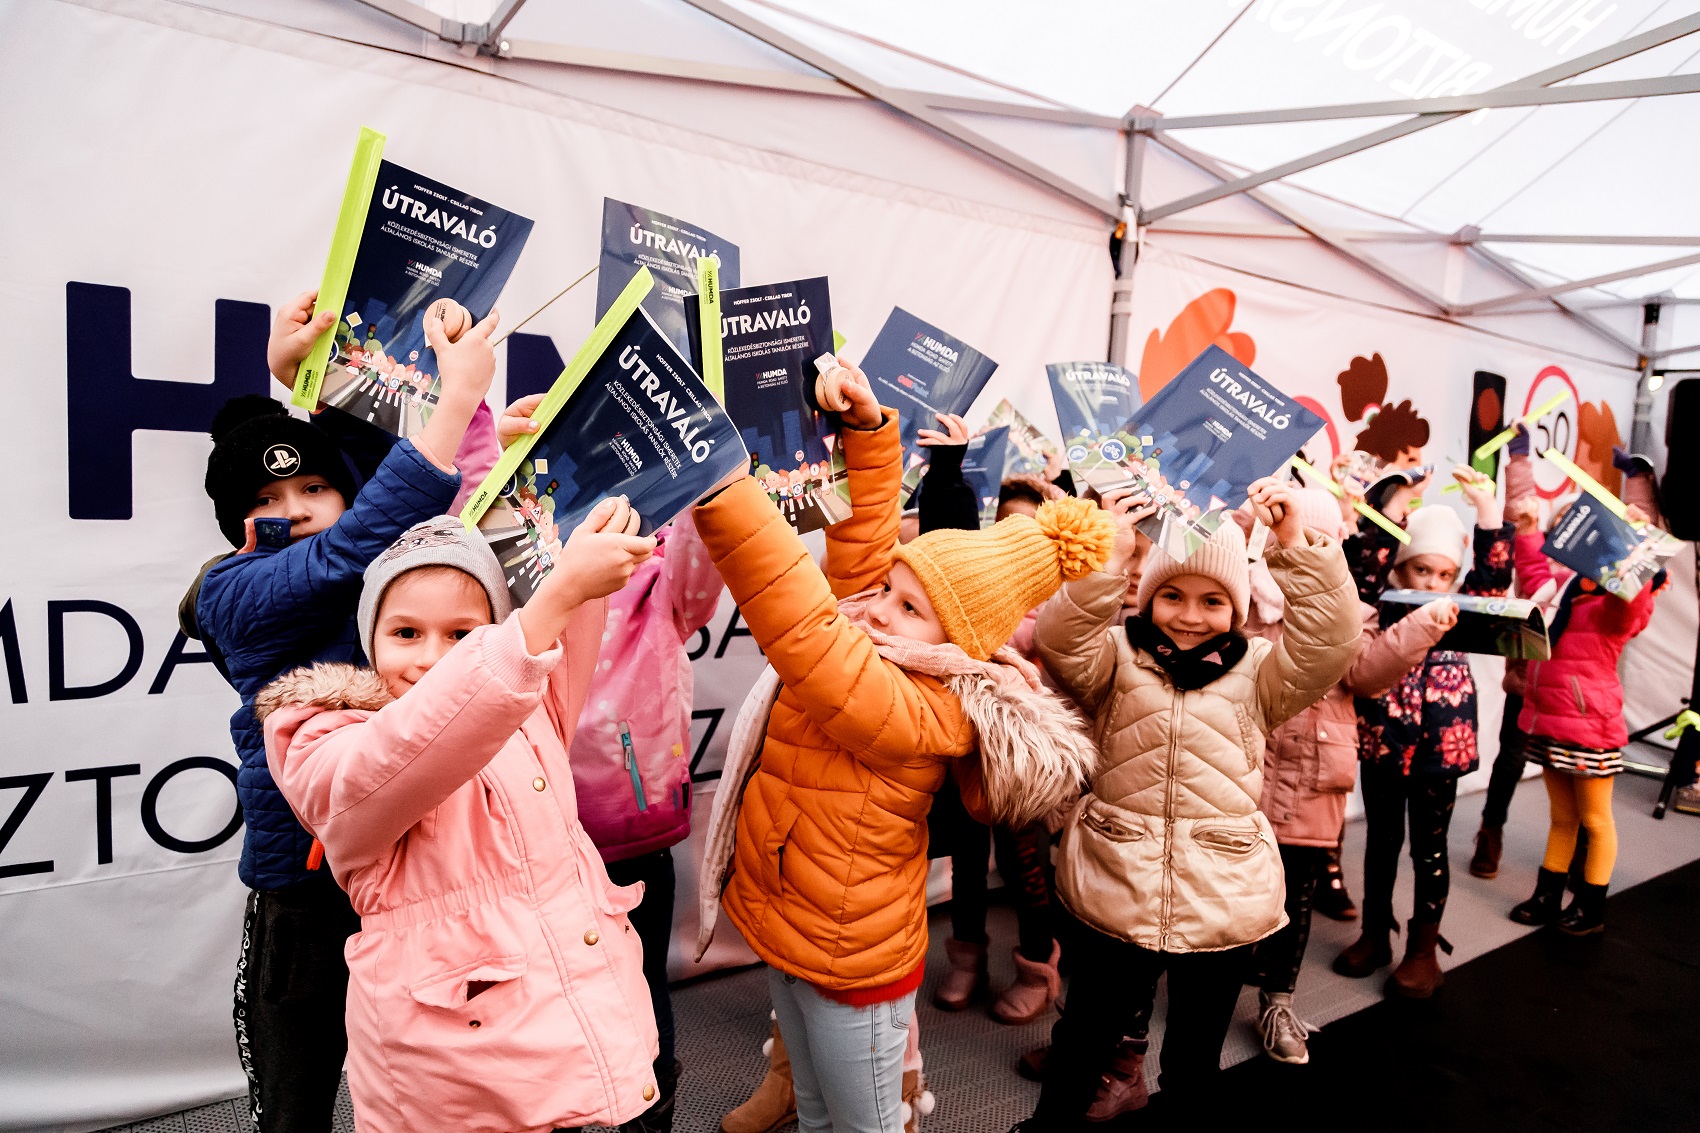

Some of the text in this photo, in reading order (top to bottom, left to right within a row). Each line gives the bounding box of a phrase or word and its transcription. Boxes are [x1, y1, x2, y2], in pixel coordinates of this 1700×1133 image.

[414, 184, 484, 216] HOFFER ZSOLT CSILLAG TIBOR
[382, 185, 496, 249] ÚTRAVALÓ
[381, 225, 413, 242] ÁLTALÁNOS
[412, 238, 435, 251] ISKOLÁS
[435, 247, 459, 261] TANULÓK
[415, 262, 443, 278] HUMDA
[724, 350, 751, 362] ÁLTALÁNOS
[752, 347, 771, 356] ISKOLÁS
[923, 336, 959, 363] HUMDA
[302, 370, 312, 391] HUMDA
[655, 354, 713, 423] HOFFER ZSOLT CSILLAG TIBOR
[763, 368, 787, 379] HUMDA
[618, 345, 715, 463] ÚTRAVALÓ
[1210, 368, 1292, 428] ÚTRAVALÓ
[605, 382, 678, 480] ÁLTALÁNOS ISKOLÁS TANULÓK RÉSZÉRE
[614, 380, 682, 470] KÖZLEKEDÉSBIZTONSÁGI ISMERETEK
[1212, 421, 1233, 438] HUMDA
[621, 438, 643, 469] HUMDA
[472, 491, 488, 512] HUMDA
